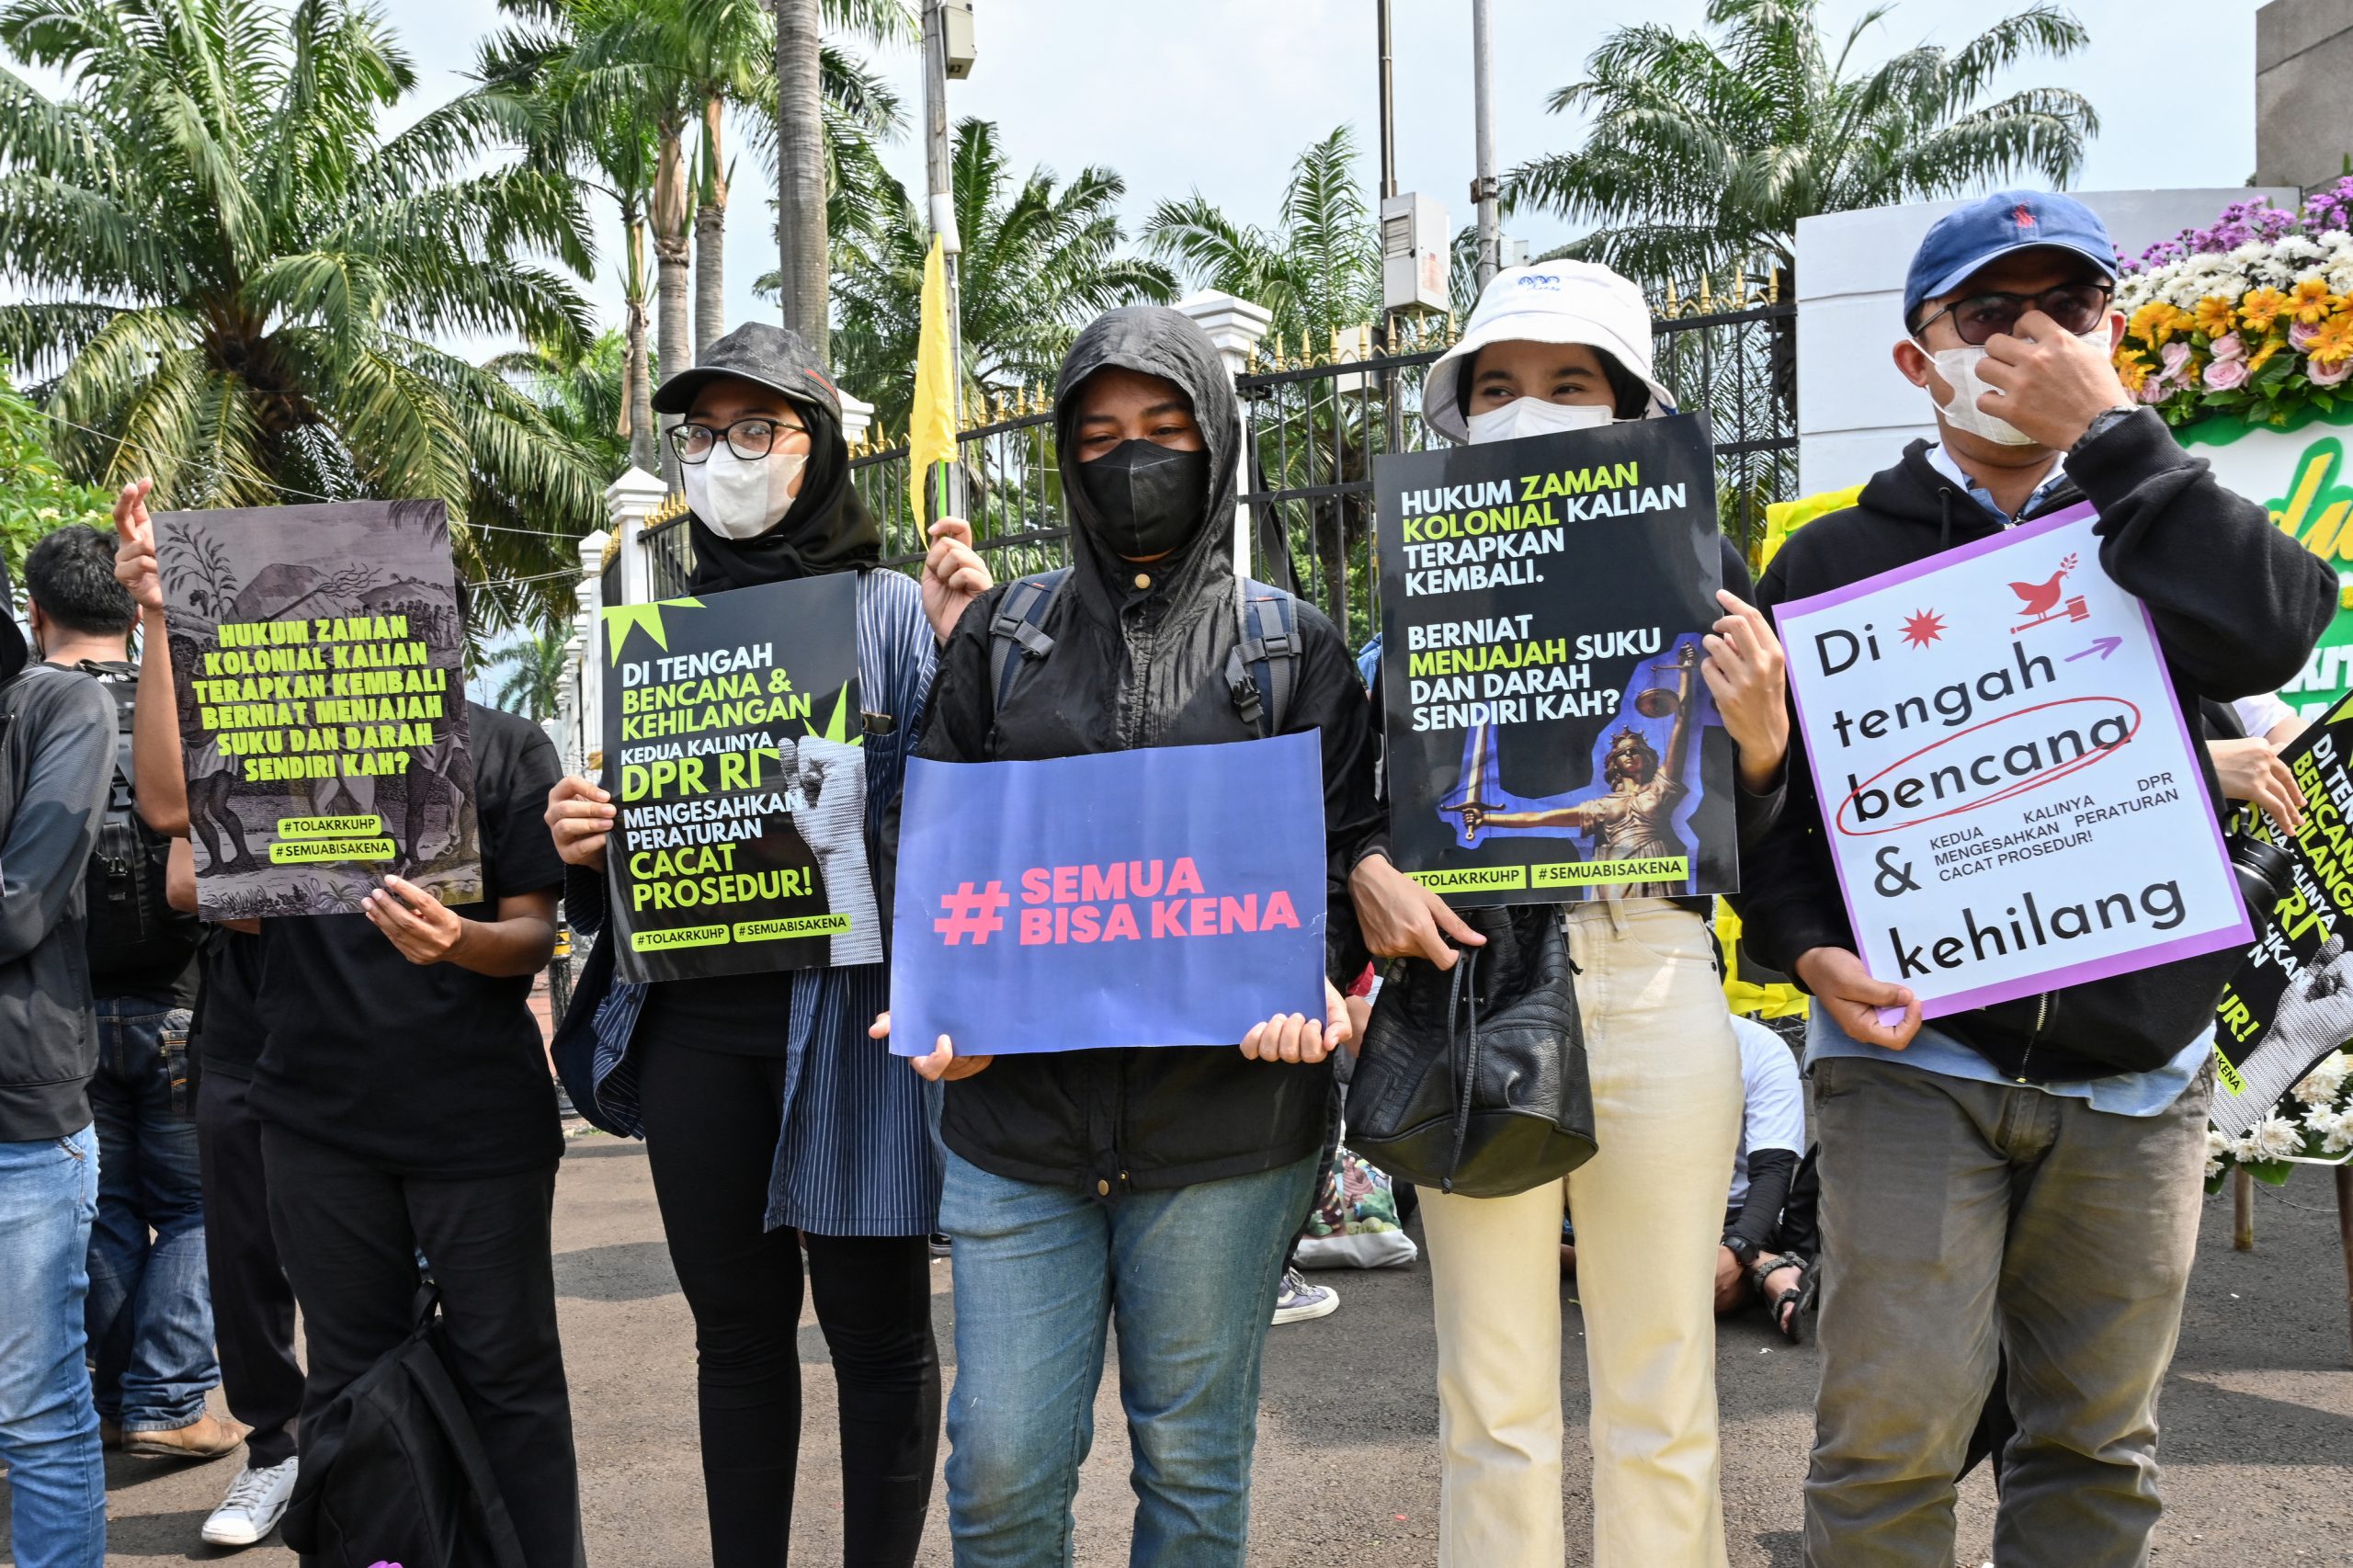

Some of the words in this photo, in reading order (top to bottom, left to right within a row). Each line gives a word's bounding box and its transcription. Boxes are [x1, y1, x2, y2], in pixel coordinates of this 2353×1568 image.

[1402, 479, 1513, 517] HUKUM
[1519, 461, 1638, 502] ZAMAN
[1403, 501, 1559, 543] KOLONIAL
[1567, 483, 1687, 523] KALIAN
[1404, 527, 1564, 570] TERAPKAN
[1405, 559, 1544, 597] KEMBALI.
[218, 620, 309, 647] HUKUM
[315, 616, 407, 642] ZAMAN
[1407, 614, 1533, 651] BERNIAT
[1409, 638, 1566, 677] MENJAJAH
[1574, 627, 1661, 661] SUKU
[1814, 623, 1881, 677] Di
[204, 649, 326, 676] KOLONIAL
[334, 642, 427, 668] KALIAN
[622, 663, 649, 687] DI
[656, 642, 772, 682] TENGAH
[192, 676, 325, 703] TERAPKAN
[332, 669, 446, 697] KEMBALI
[622, 672, 761, 715] BENCANA
[767, 667, 792, 693] &
[1410, 675, 1475, 705] DAN
[1483, 664, 1591, 699] DARAH
[1833, 641, 2057, 748] tengah
[201, 702, 306, 730] BERNIAT
[315, 695, 442, 723] MENJAJAH
[621, 693, 812, 742] KEHILANGAN
[1411, 698, 1527, 732] SENDIRI
[1536, 688, 1620, 722] KAH?
[216, 731, 282, 756] SUKU
[290, 726, 338, 752] DAN
[347, 723, 433, 749] DARAH
[621, 745, 683, 765] KEDUA
[688, 732, 774, 756] KALINYA
[244, 756, 336, 782] SENDIRI
[343, 751, 410, 777] KAH?
[621, 757, 710, 802] DPR
[720, 749, 762, 791] RI
[1847, 714, 2131, 823] bencana
[2313, 733, 2337, 769] DI
[2325, 764, 2353, 825] TEN
[284, 818, 376, 833] #TOLAKRKUHP
[623, 791, 804, 828] MENGESAHKAN
[1929, 826, 1984, 850] KEDUA
[2023, 794, 2095, 825] KALINYA
[2137, 772, 2174, 793] DPR
[1934, 821, 2060, 867] MENGESAHKAN
[2075, 789, 2179, 828] PERATURAN
[2293, 750, 2353, 874] BENCAN
[275, 843, 390, 858] #SEMUABISAKENA
[628, 818, 763, 851] PERATURAN
[1938, 858, 1993, 882] CACAT
[1998, 831, 2094, 868] PROSEDUR!
[630, 844, 736, 879] CACAT
[1020, 857, 1205, 904] SEMUA
[1538, 859, 1682, 881] #SEMUABISAKENA
[1873, 846, 1922, 898] &
[2260, 808, 2288, 848] DUA
[2289, 847, 2336, 931] ALINYA
[632, 866, 813, 912] PROSEDUR!
[637, 928, 724, 946] #TOLAKRKUHP
[739, 916, 847, 936] #SEMUABISAKENA
[934, 881, 1009, 946] #
[1019, 903, 1141, 946] BISA
[1151, 891, 1301, 938] KENA
[1889, 880, 2187, 980] kehilang
